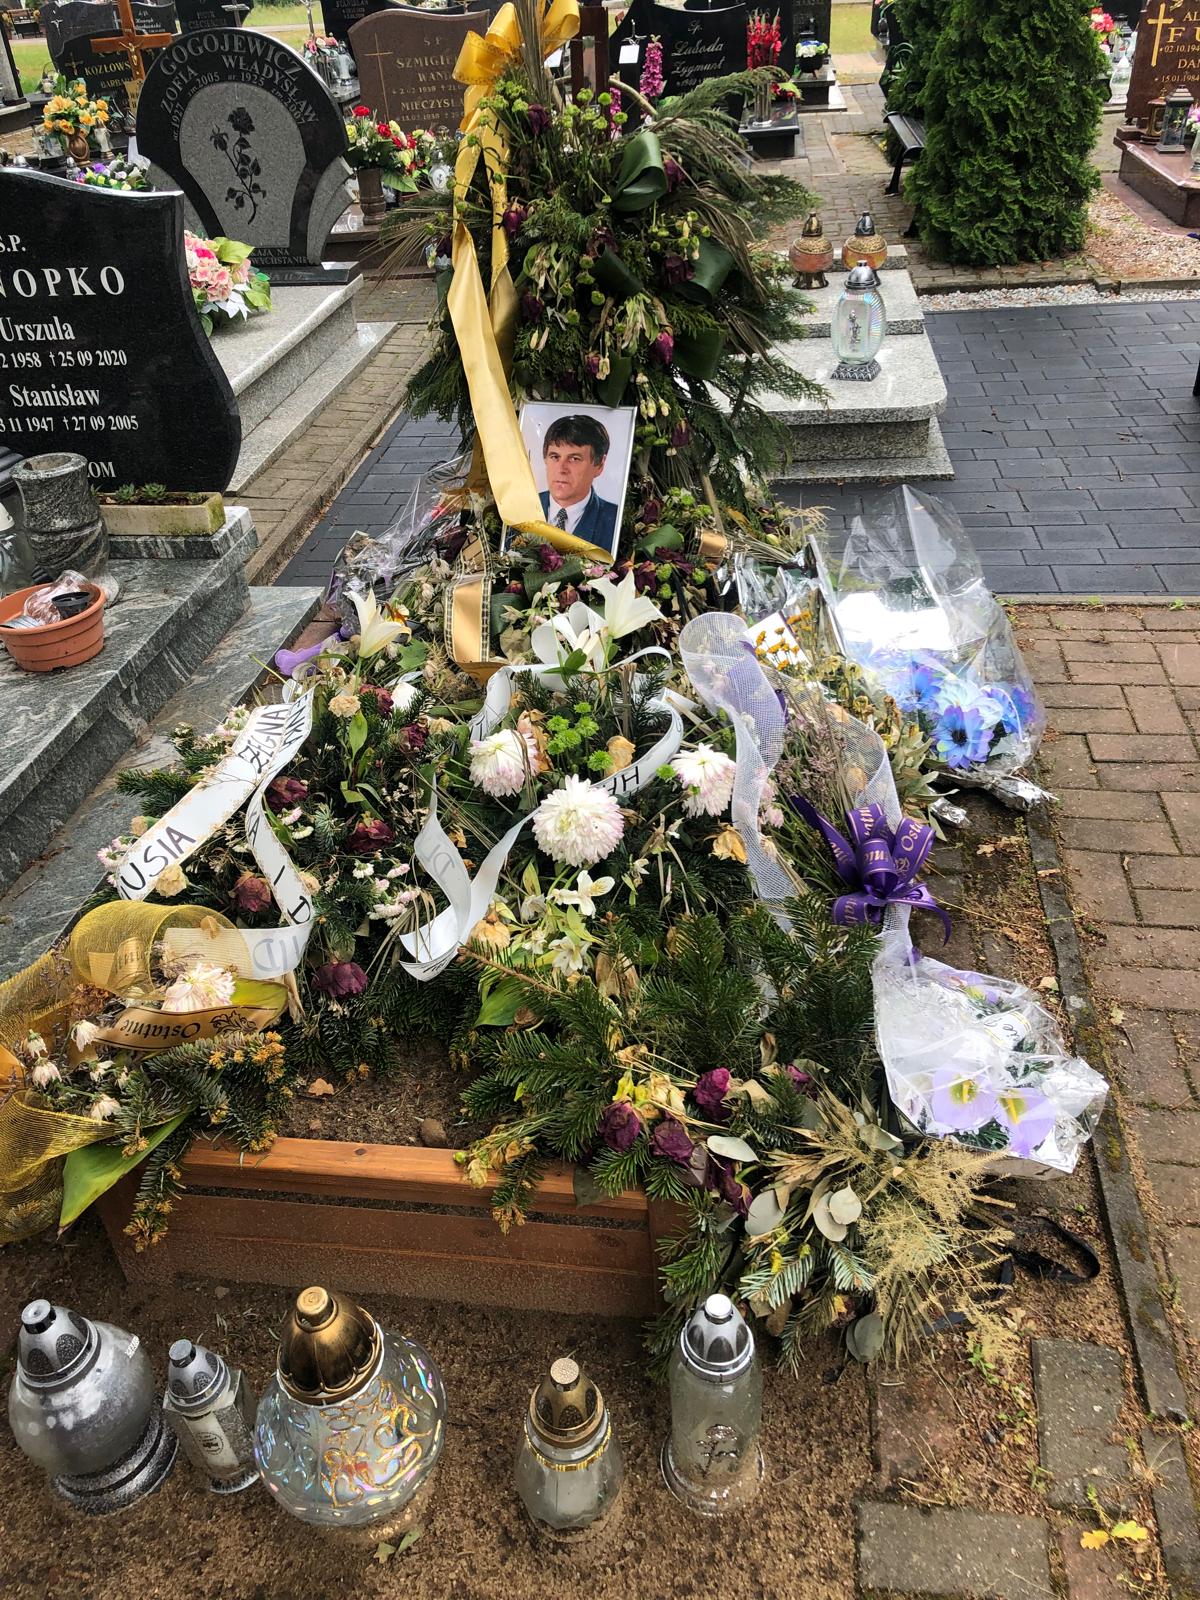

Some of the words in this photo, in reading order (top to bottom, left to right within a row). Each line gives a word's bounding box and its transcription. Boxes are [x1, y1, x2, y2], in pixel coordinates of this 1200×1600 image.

[160, 33, 302, 82] GOGOJEWICZ
[671, 56, 726, 77] Zygmunt
[160, 65, 199, 114] ZOFIA
[197, 72, 220, 88] 2005
[221, 54, 319, 122] WŁADYSŁAW
[241, 72, 265, 87] 1925
[0, 315, 76, 342] Urszula
[10, 351, 42, 369] 1958
[58, 350, 75, 367] 25
[76, 350, 93, 367] 09
[95, 349, 128, 366] 2020
[9, 383, 100, 408] Stanisław
[8, 417, 23, 433] 11
[25, 416, 54, 432] 1947
[71, 416, 87, 431] 27
[89, 415, 106, 431] 09
[107, 414, 139, 431] 2005
[119, 1019, 201, 1039] Ostatnie
